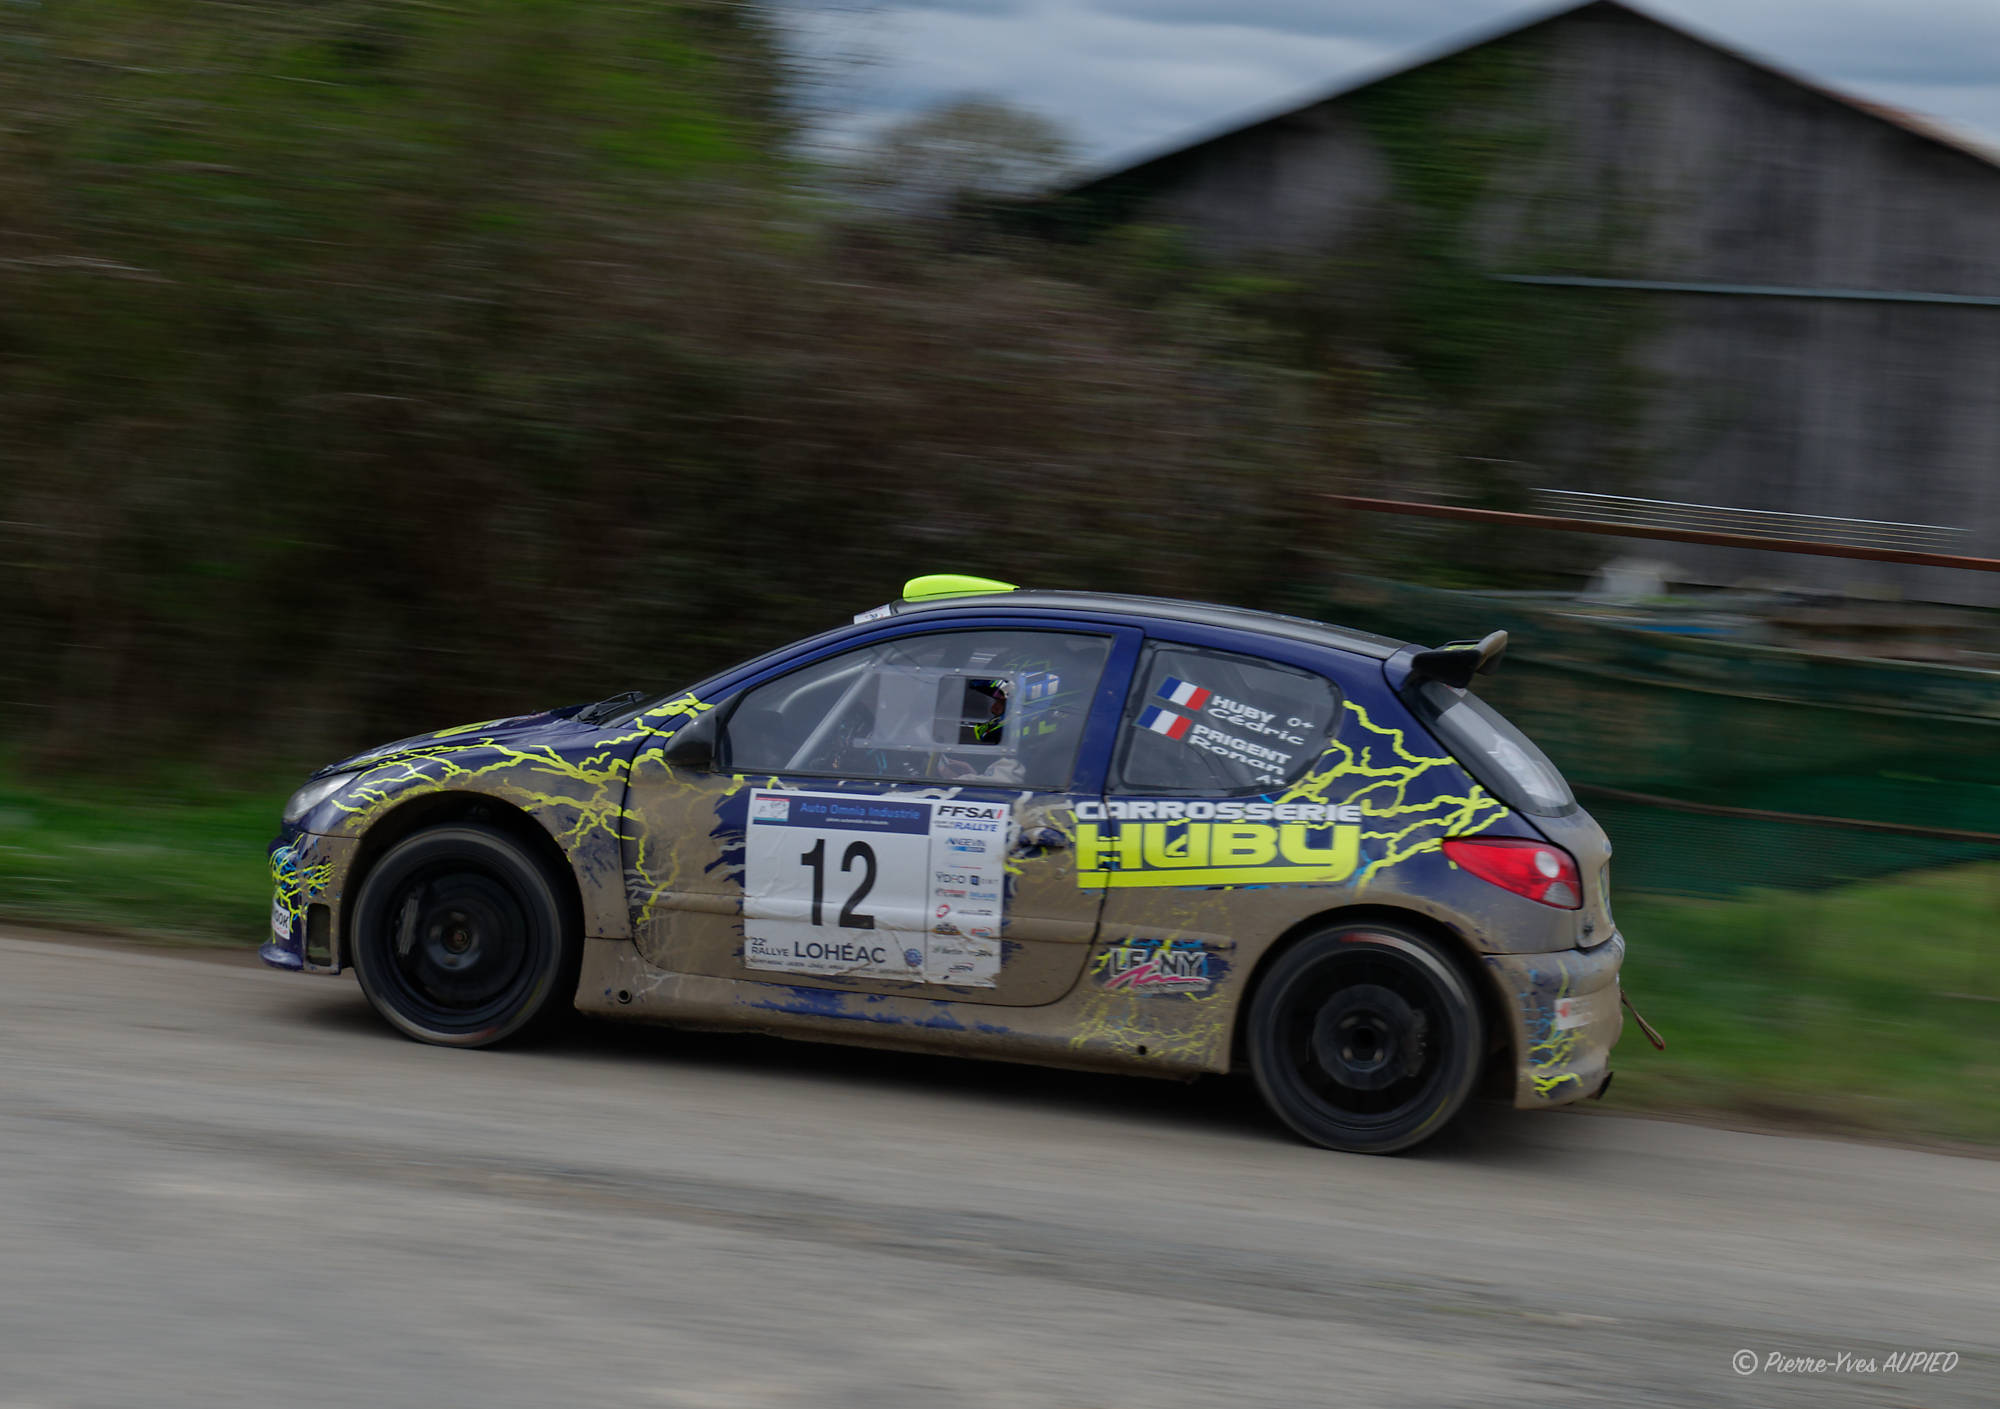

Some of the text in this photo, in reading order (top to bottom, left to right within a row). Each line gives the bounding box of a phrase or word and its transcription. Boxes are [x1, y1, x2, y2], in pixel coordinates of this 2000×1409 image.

[1211, 695, 1277, 723] HUBY
[1208, 708, 1305, 745] Cédric
[1188, 735, 1286, 775] Ronan
[1192, 724, 1292, 765] PRIGENT
[800, 802, 827, 814] Auto
[830, 804, 866, 816] Omnia
[868, 807, 921, 820] Industrie
[938, 805, 994, 819] FFSA
[1074, 801, 1362, 823] CARROSSERIE
[954, 821, 999, 833] RALLYE
[1076, 822, 1361, 888] HUBY
[801, 838, 878, 930] 12
[751, 946, 789, 957] RALLYE
[794, 941, 887, 963] LOHÉAC
